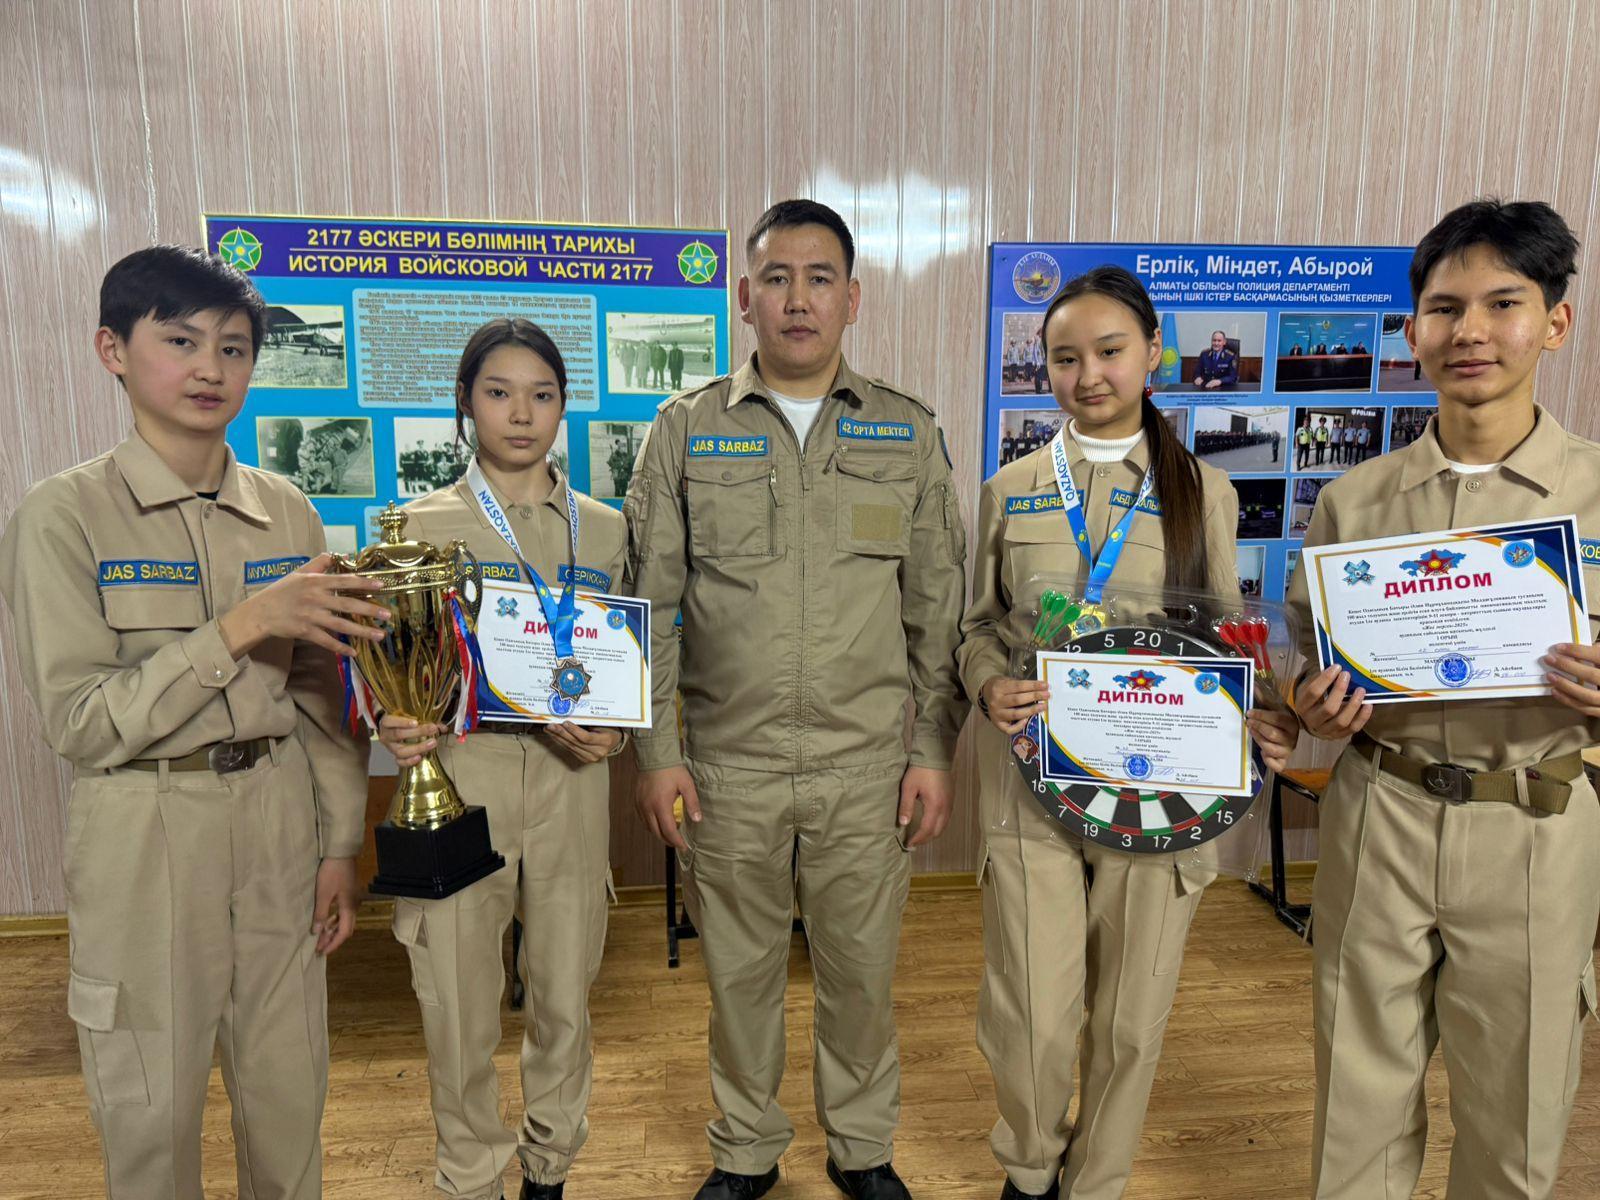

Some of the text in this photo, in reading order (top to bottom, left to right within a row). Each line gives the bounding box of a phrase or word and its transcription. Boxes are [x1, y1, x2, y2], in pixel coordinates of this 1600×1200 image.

[307, 228, 635, 255] 2177 ӘСКЕРИ БӨЛІМНІҢ ТАРИХЫ
[288, 253, 654, 281] ИСТОРИЯ ВОЙСКОВОЙ ЧАСТИ 2177
[1136, 254, 1373, 280] Ерлік, Міндет, Абырой
[1149, 281, 1350, 293] АЛМАТЫ ОБЛЫСЫ ПОЛИЦИЯ ДЕПАРТАМЕНТІ
[1184, 292, 1204, 301] ІШКІ
[1205, 292, 1232, 302] ІСТЕР
[1233, 292, 1318, 304] БАСҚАРМАСЫНЫҢ
[1319, 293, 1392, 304] ҚЫЗМЕТКЕРЛЕРІ
[842, 421, 910, 437] 42 ОРТА МЕКТЕП
[692, 439, 765, 453] JAS SARBAZ
[1055, 441, 1076, 502] QAZAQSTAN
[1008, 494, 1081, 511] JAS SARB
[102, 563, 195, 581] JAS SARBAZ
[465, 565, 518, 579] SRBAZ
[1383, 572, 1492, 599] ДИПЛОМ
[523, 620, 598, 639] ДИОМ
[1103, 633, 1115, 647] 5
[1133, 631, 1162, 648] 20
[1176, 641, 1184, 656] 1
[1097, 690, 1184, 706] ДИПЛОМ
[1030, 777, 1047, 794] 16
[1057, 805, 1069, 819] 7
[1215, 809, 1234, 825] 15
[1082, 822, 1099, 838] 19
[1190, 825, 1202, 841] 2
[1121, 833, 1132, 848] 3
[1152, 835, 1172, 849] 17
